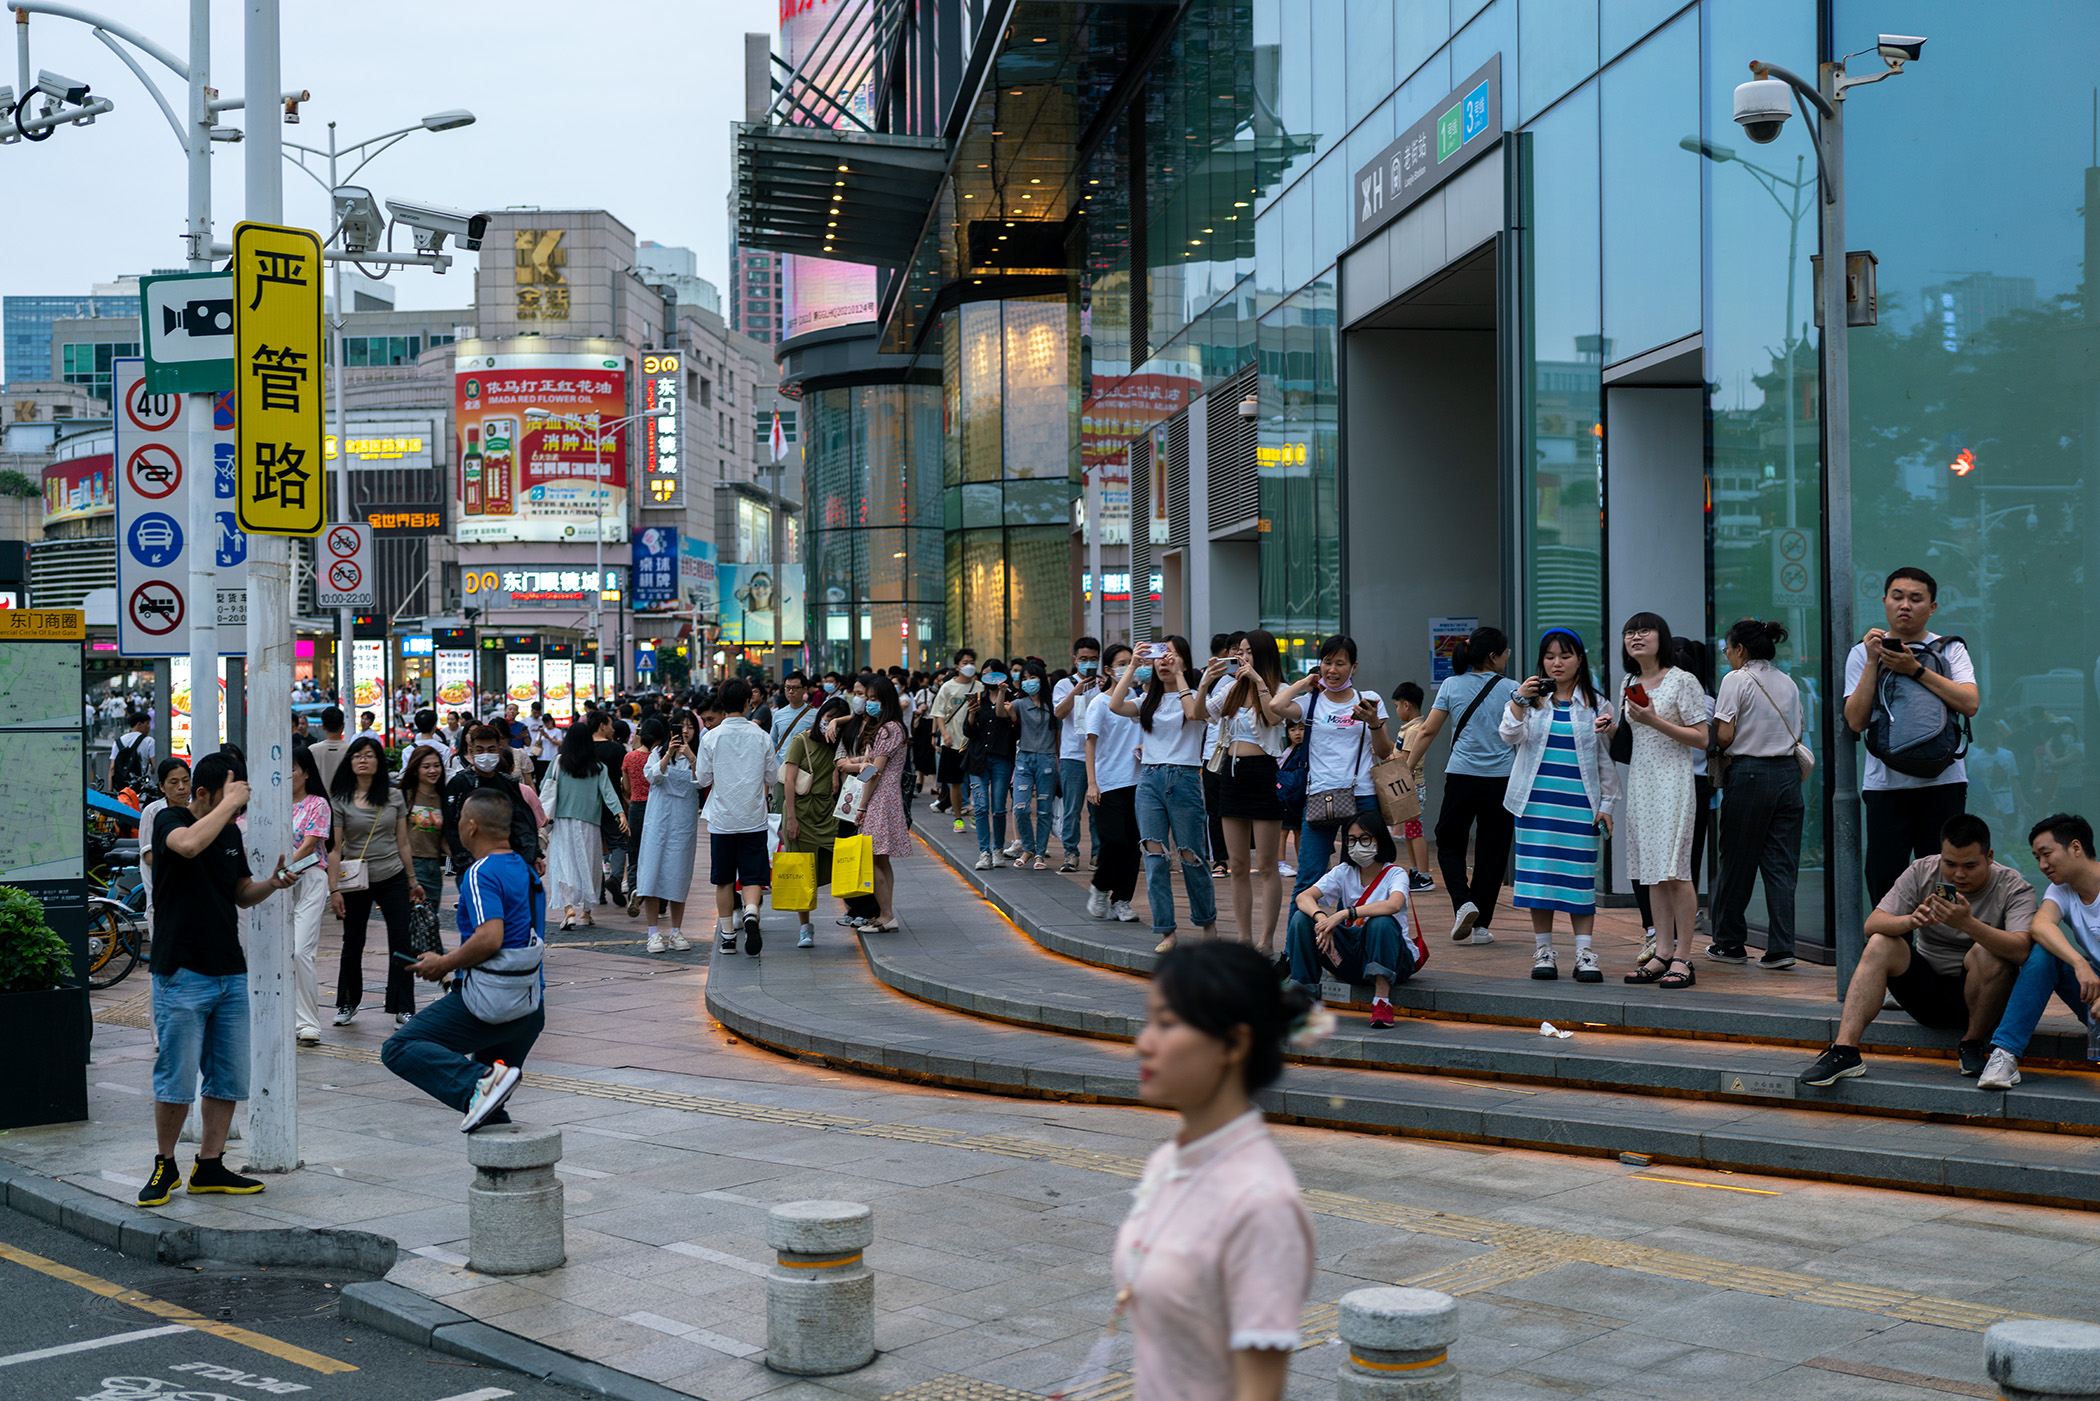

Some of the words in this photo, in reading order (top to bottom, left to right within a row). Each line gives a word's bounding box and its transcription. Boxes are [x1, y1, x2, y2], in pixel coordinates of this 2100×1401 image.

[1403, 131, 1427, 170] 老街站
[249, 249, 311, 509] 严管路
[486, 379, 612, 394] 依马打正红花油
[137, 393, 168, 417] 40
[488, 396, 516, 404] IMADA
[518, 395, 536, 403] RED
[538, 394, 576, 403] FLOWER
[578, 394, 593, 403] OIL
[657, 377, 678, 474] 东门眼镜城
[542, 433, 617, 452] 消肿止痛
[654, 491, 672, 502] 4F
[639, 557, 671, 572] 桌球
[503, 571, 599, 592] 东门眼镜城
[639, 573, 671, 588] 棋牌
[321, 593, 371, 604] 10:00-22:00
[10, 612, 77, 629] 东门商圈
[1388, 778, 1411, 797] TTL
[168, 1352, 313, 1394] BICYCLE
